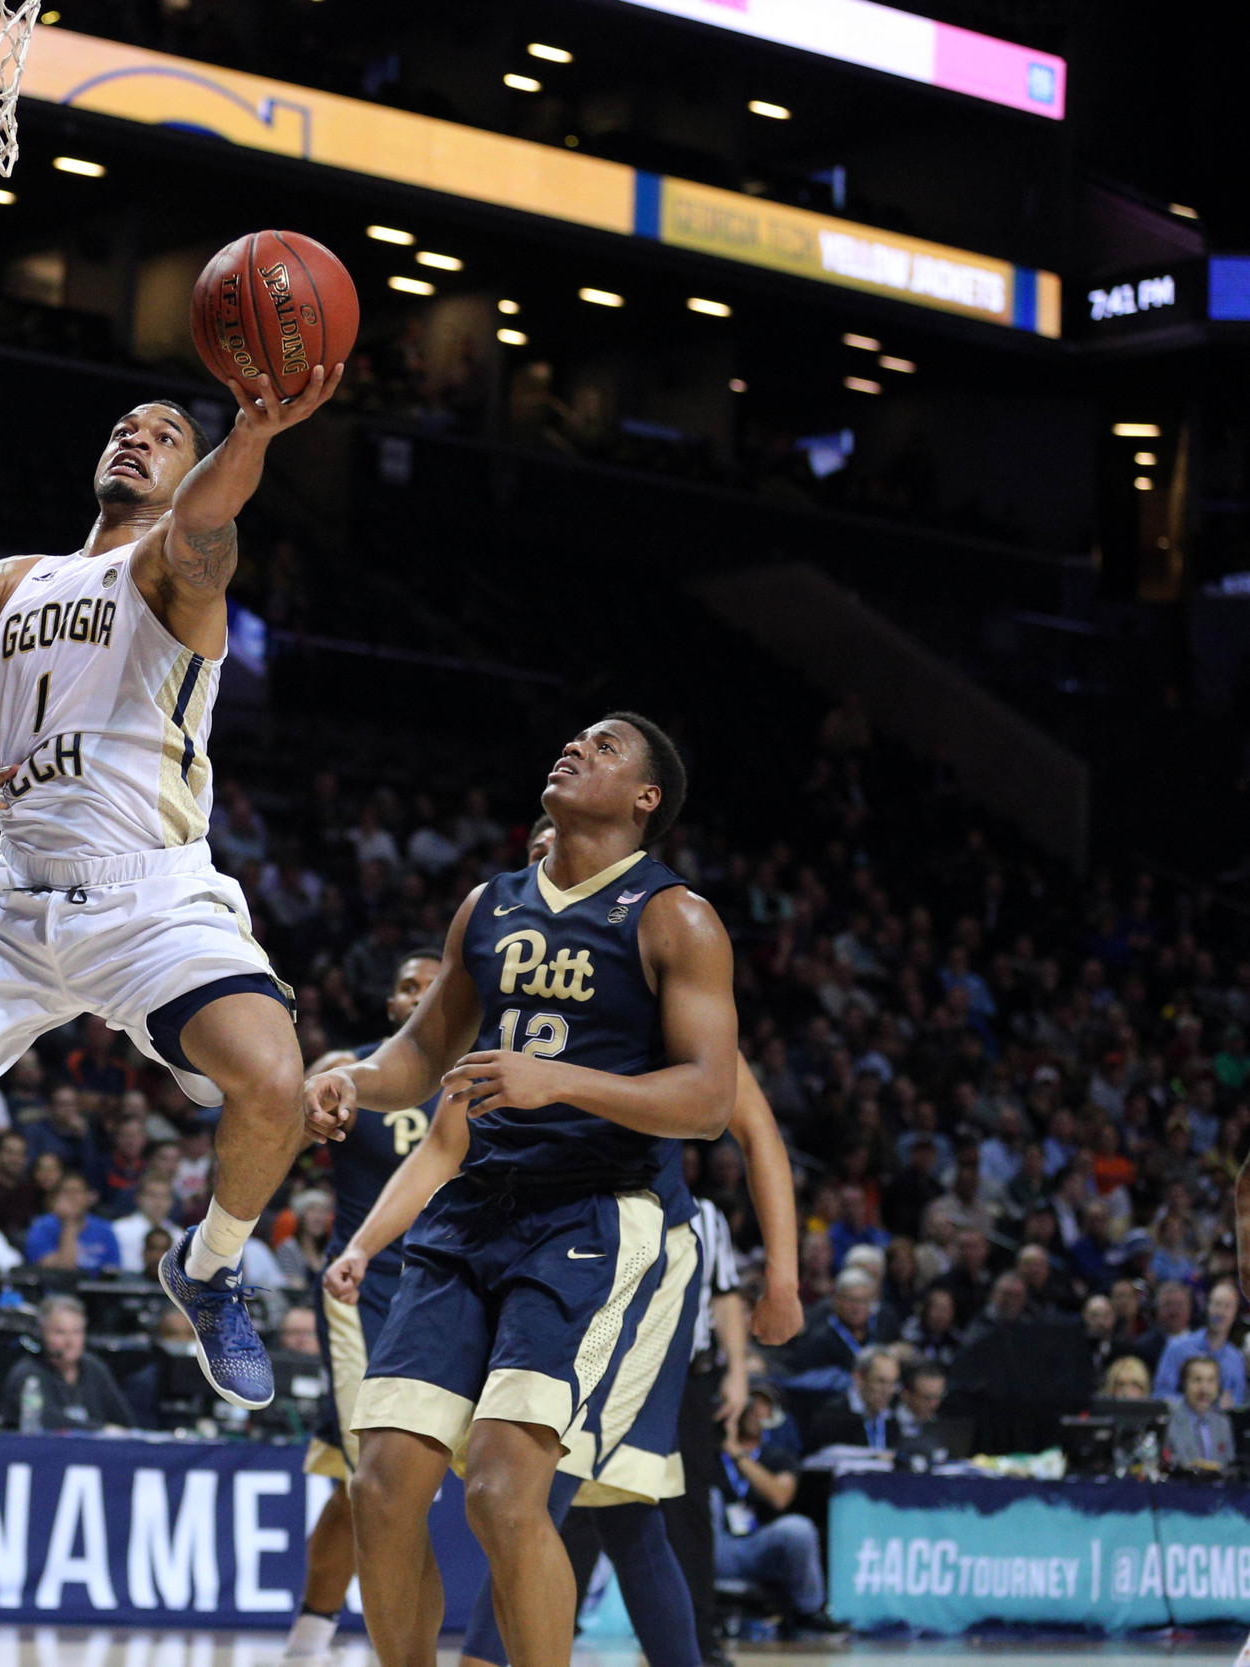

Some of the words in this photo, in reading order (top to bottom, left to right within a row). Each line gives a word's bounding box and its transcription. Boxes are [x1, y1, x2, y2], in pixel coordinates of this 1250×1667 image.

[257, 262, 310, 376] SPALDING
[33, 671, 52, 736] 1
[494, 929, 596, 1002] Pitt
[499, 1008, 570, 1059] 12
